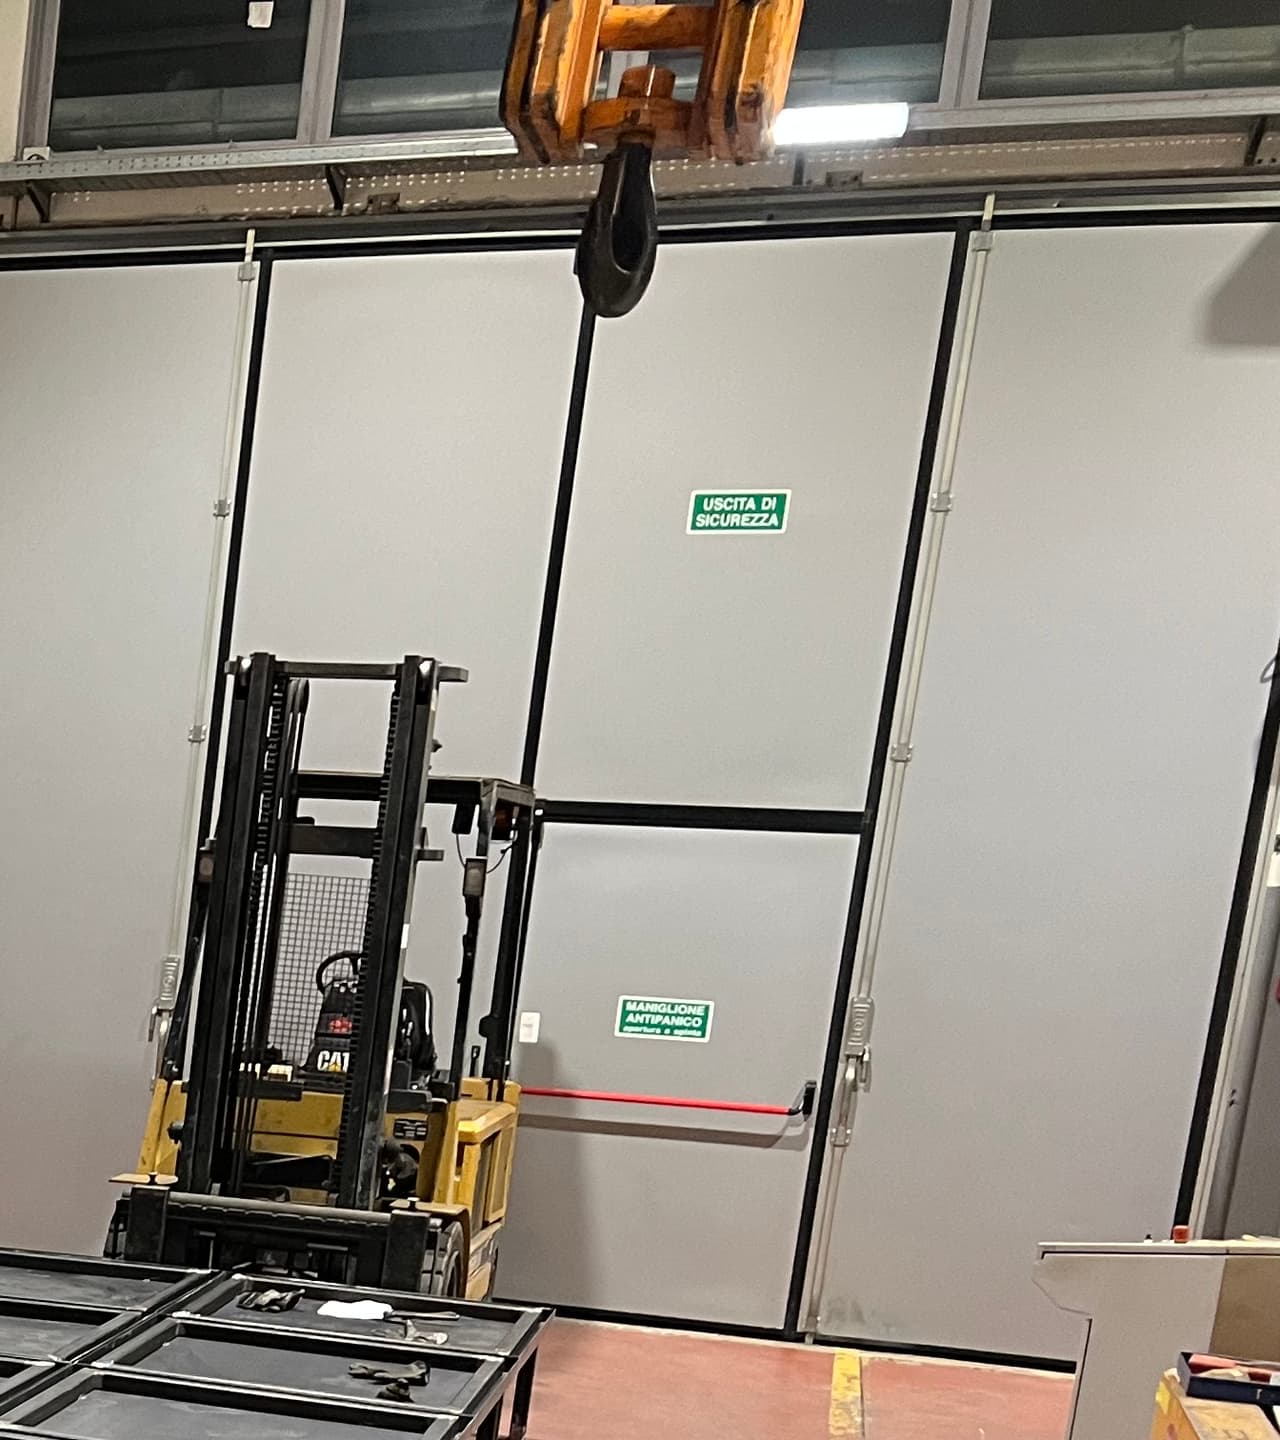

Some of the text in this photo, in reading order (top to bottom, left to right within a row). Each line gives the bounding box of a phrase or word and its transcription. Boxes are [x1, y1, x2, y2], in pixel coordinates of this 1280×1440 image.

[703, 497, 777, 511] USCITA DI
[695, 513, 779, 527] SICUREZZA
[625, 1001, 705, 1016] MANIGLIONE
[625, 1013, 703, 1028] ANTIPANICO
[317, 1050, 350, 1073] CAT
